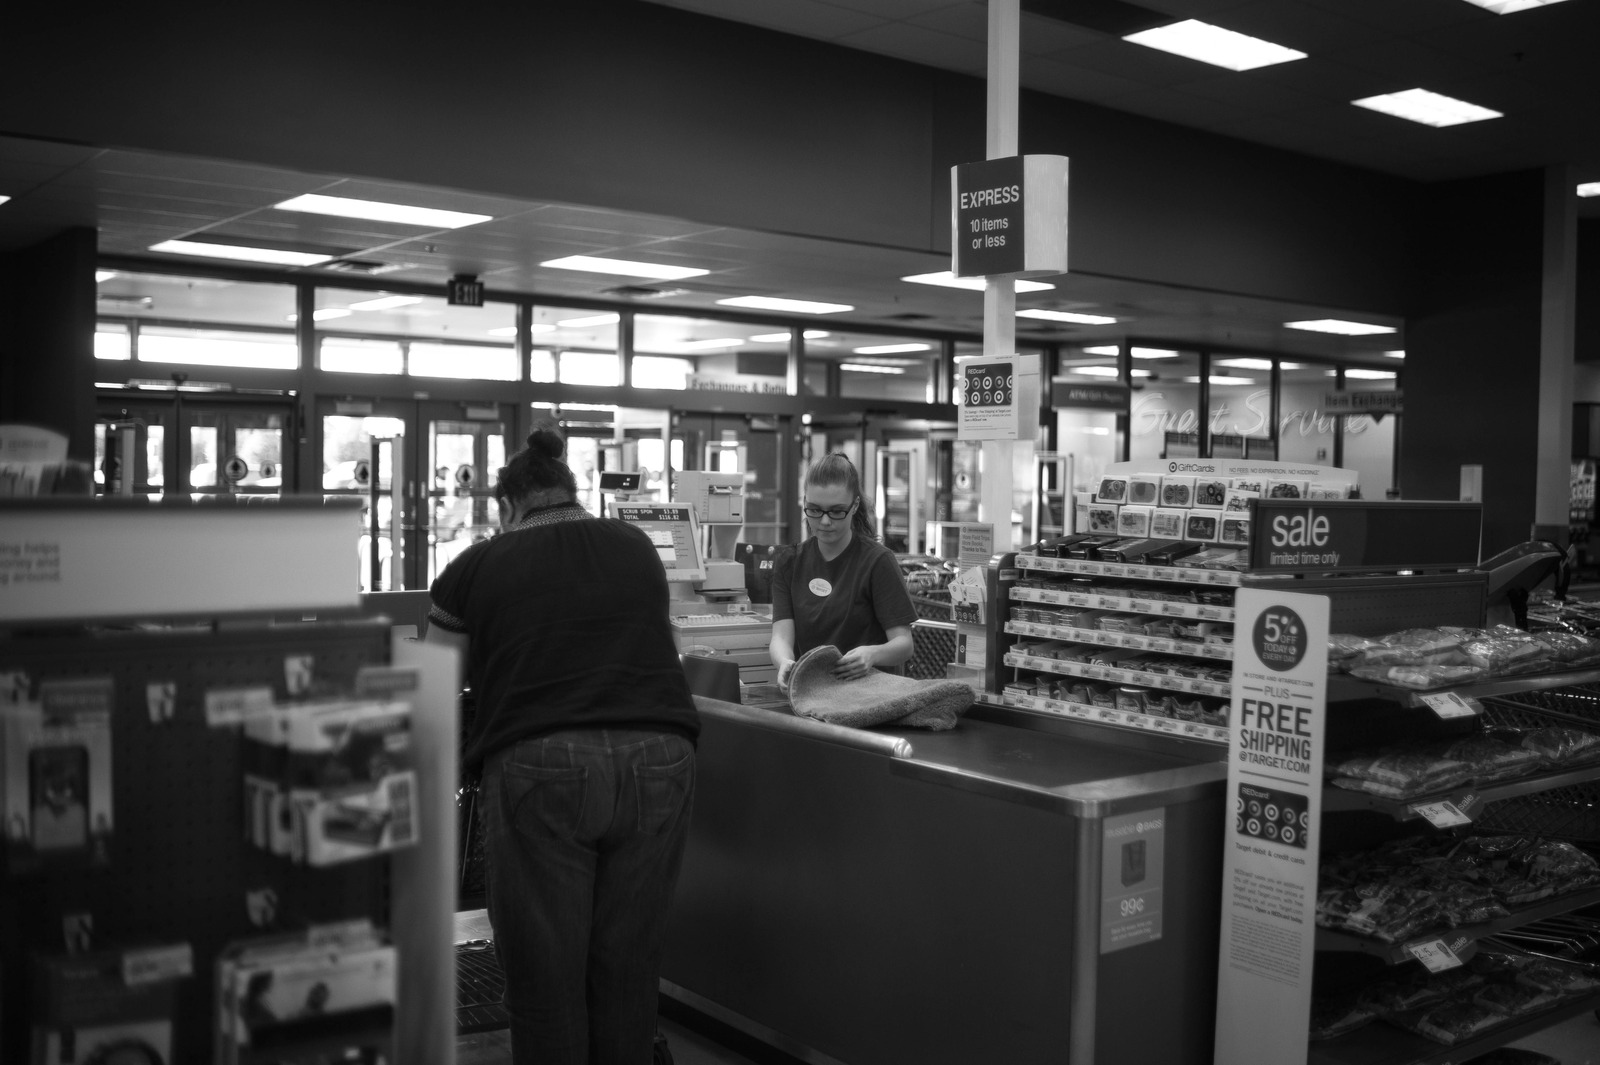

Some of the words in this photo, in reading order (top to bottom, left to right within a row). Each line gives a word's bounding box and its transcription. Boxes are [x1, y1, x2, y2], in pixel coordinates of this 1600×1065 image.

[960, 185, 1020, 210] EXPRESS
[970, 218, 980, 233] 10
[981, 216, 1009, 232] items
[972, 238, 983, 249] or
[985, 235, 1006, 248] less
[455, 283, 479, 304] EXIT
[1178, 463, 1215, 472] GiftCards
[1271, 507, 1330, 547] sale
[1270, 551, 1299, 565] limited
[1301, 551, 1320, 564] time
[1321, 550, 1340, 567] only
[1264, 613, 1298, 643] 5%
[1263, 642, 1288, 654] TODAY
[1280, 635, 1298, 645] OFF
[1262, 652, 1283, 661] EVERY
[1283, 654, 1297, 663] DAY
[1264, 685, 1290, 699] PLUS
[1241, 698, 1312, 738] FREE
[1239, 728, 1311, 761] SHIPPING
[1239, 750, 1310, 775] @TARGET.COM
[1241, 786, 1270, 800] REDcard
[1457, 794, 1474, 811] sale
[1235, 842, 1252, 853] Target
[1290, 856, 1305, 865] cards
[1450, 936, 1468, 952] sale
